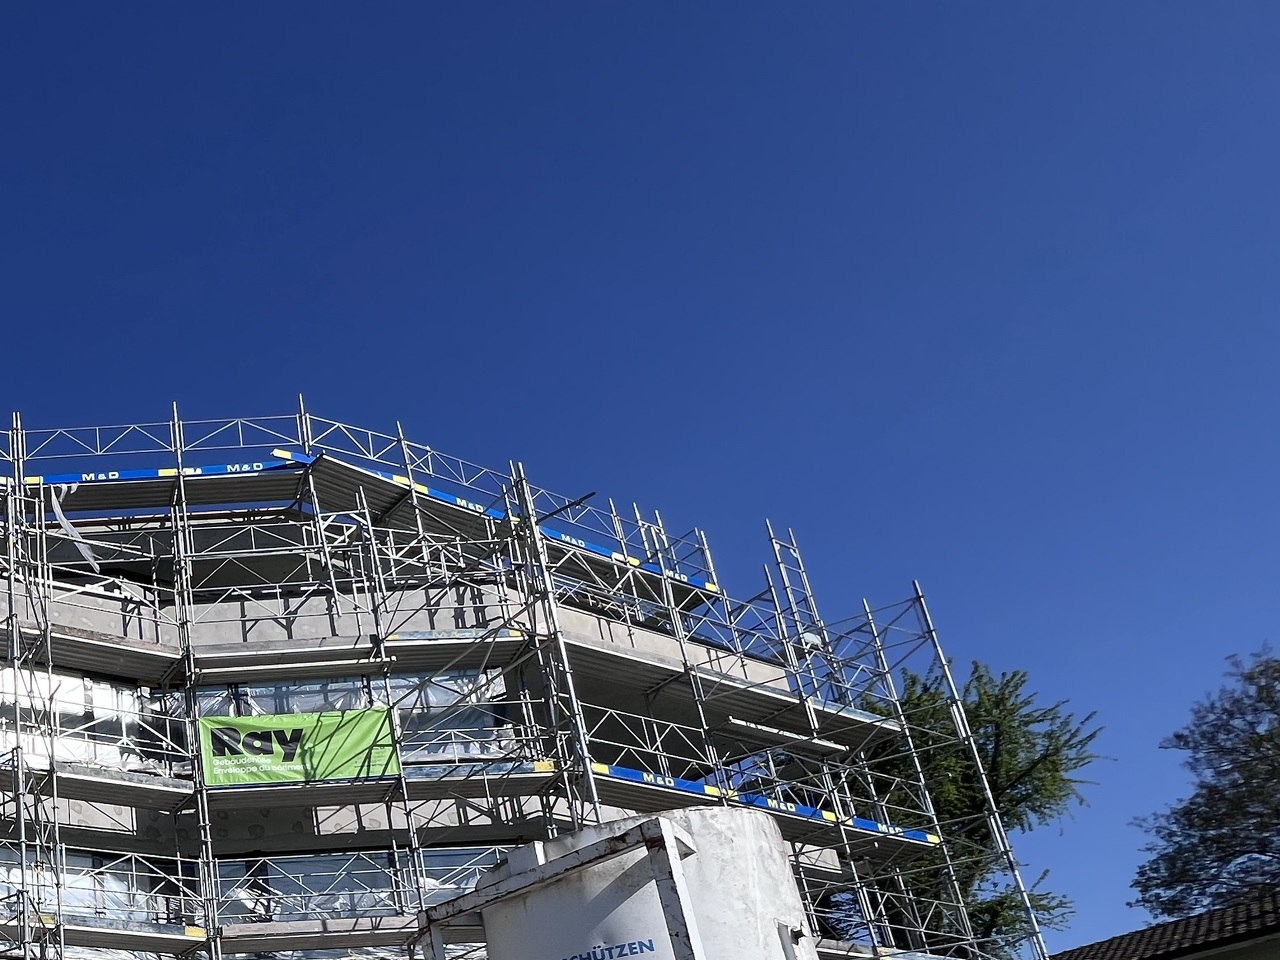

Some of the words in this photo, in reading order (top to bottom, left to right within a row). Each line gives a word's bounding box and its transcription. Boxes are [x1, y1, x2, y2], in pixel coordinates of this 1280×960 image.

[210, 727, 303, 763] Ray
[213, 766, 257, 775] Enveloppe
[259, 764, 271, 772] du
